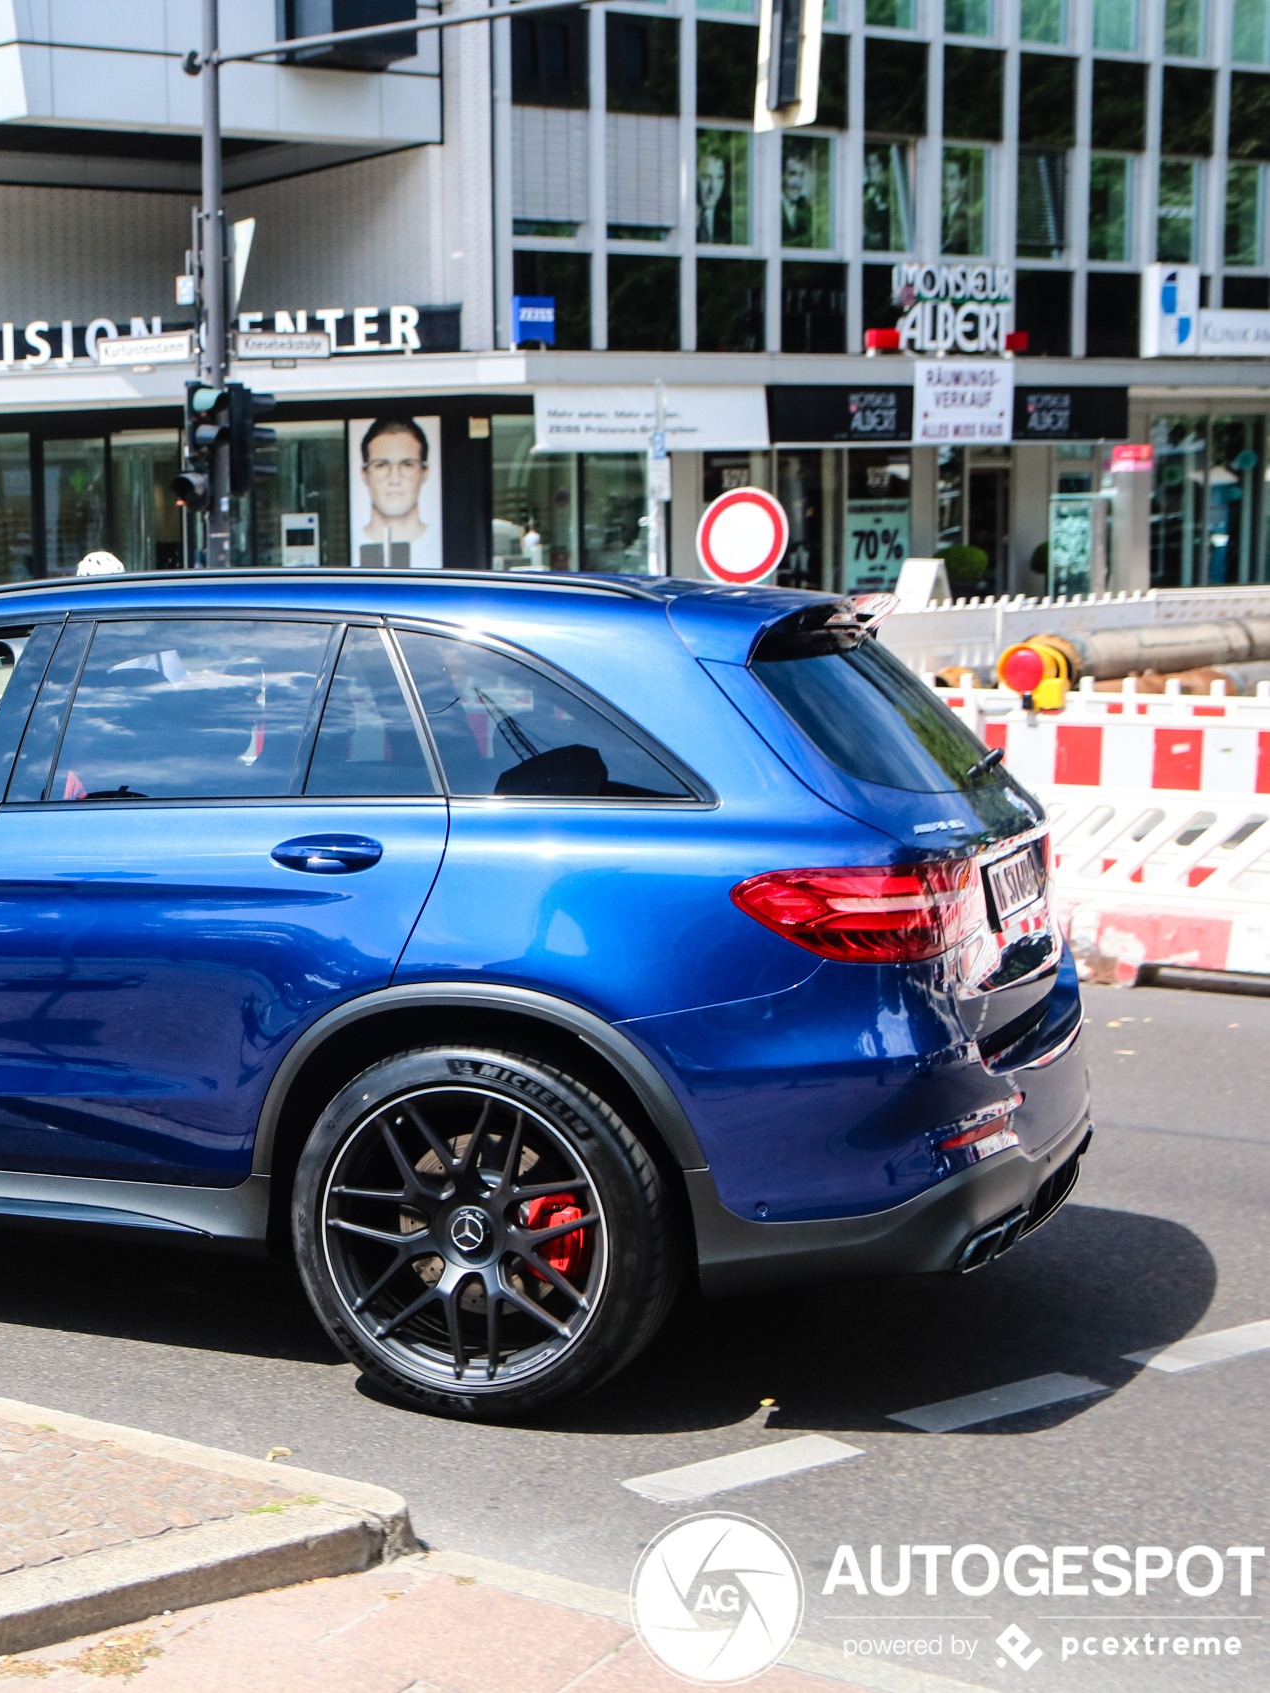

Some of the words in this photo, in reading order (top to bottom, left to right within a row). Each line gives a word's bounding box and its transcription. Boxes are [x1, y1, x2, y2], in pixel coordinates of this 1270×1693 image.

[892, 263, 1013, 301] MONSIEUR
[519, 308, 554, 321] ZEISS
[898, 301, 1011, 351] ALBERT
[199, 305, 422, 353] ENTER
[104, 339, 185, 358] Kurfürstendamm
[926, 365, 1000, 387] RÄUMUNGS-
[934, 390, 992, 409] VERKAUF
[922, 423, 948, 438] ALLES
[852, 528, 904, 561] 70%
[478, 1063, 591, 1138] MICHELIN
